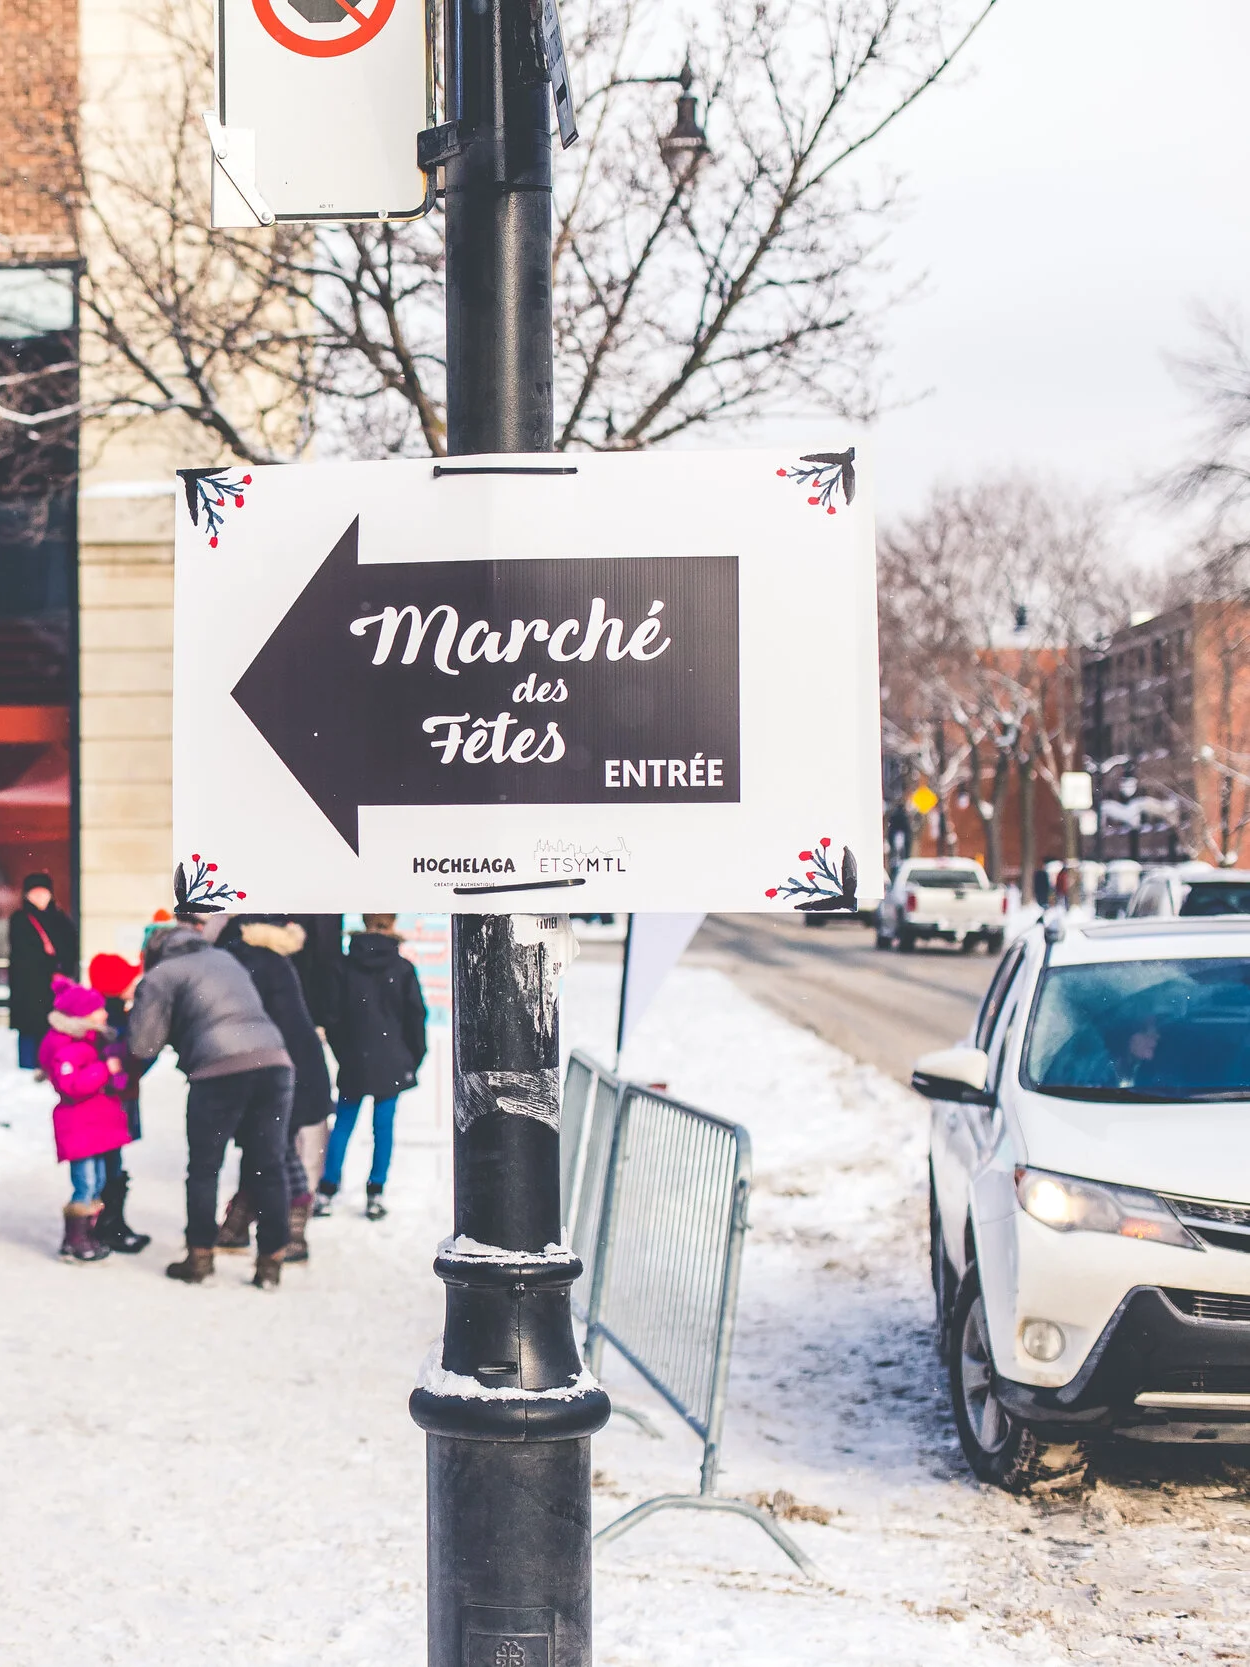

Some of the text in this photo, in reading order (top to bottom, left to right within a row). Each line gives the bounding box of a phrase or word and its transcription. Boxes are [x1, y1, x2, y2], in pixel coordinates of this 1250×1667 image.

[350, 597, 671, 676] Marché
[511, 672, 569, 703] des
[421, 711, 566, 765] Fêtes
[604, 752, 724, 788] ENTRÉE
[412, 857, 516, 874] HOCHELAGA
